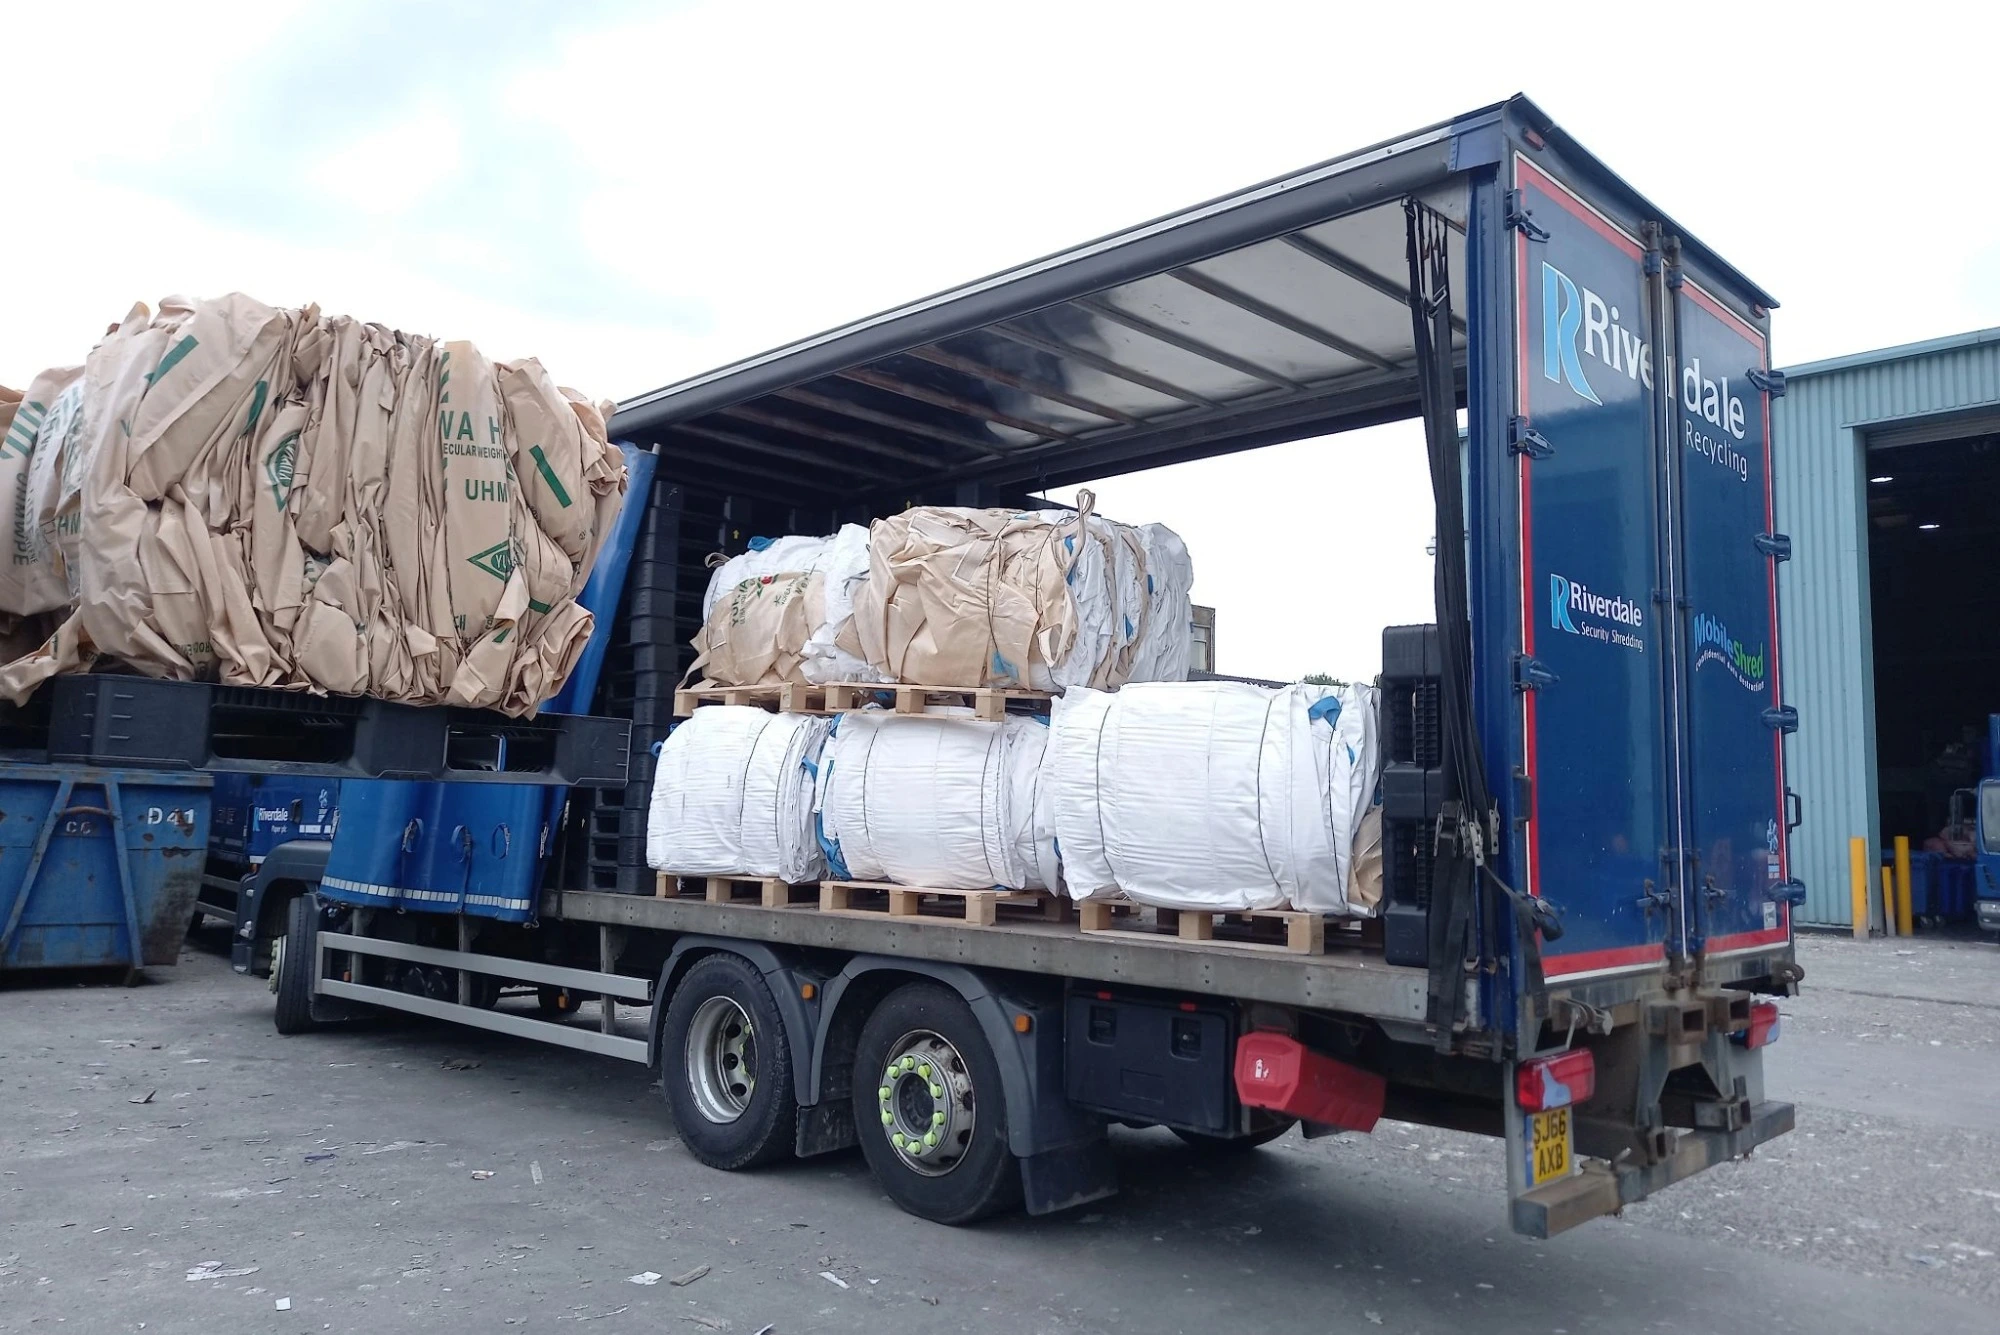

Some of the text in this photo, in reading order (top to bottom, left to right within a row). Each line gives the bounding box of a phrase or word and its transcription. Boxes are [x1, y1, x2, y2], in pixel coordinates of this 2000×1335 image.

[1685, 419, 1748, 482] Recycling
[1570, 581, 1643, 627] Riverdale
[1581, 621, 1643, 653] Security Shredding
[1694, 612, 1764, 679] MobileShred
[258, 807, 288, 821] Riverdale
[1534, 1109, 1566, 1145] SJ66
[1538, 1143, 1563, 1177] AXB
